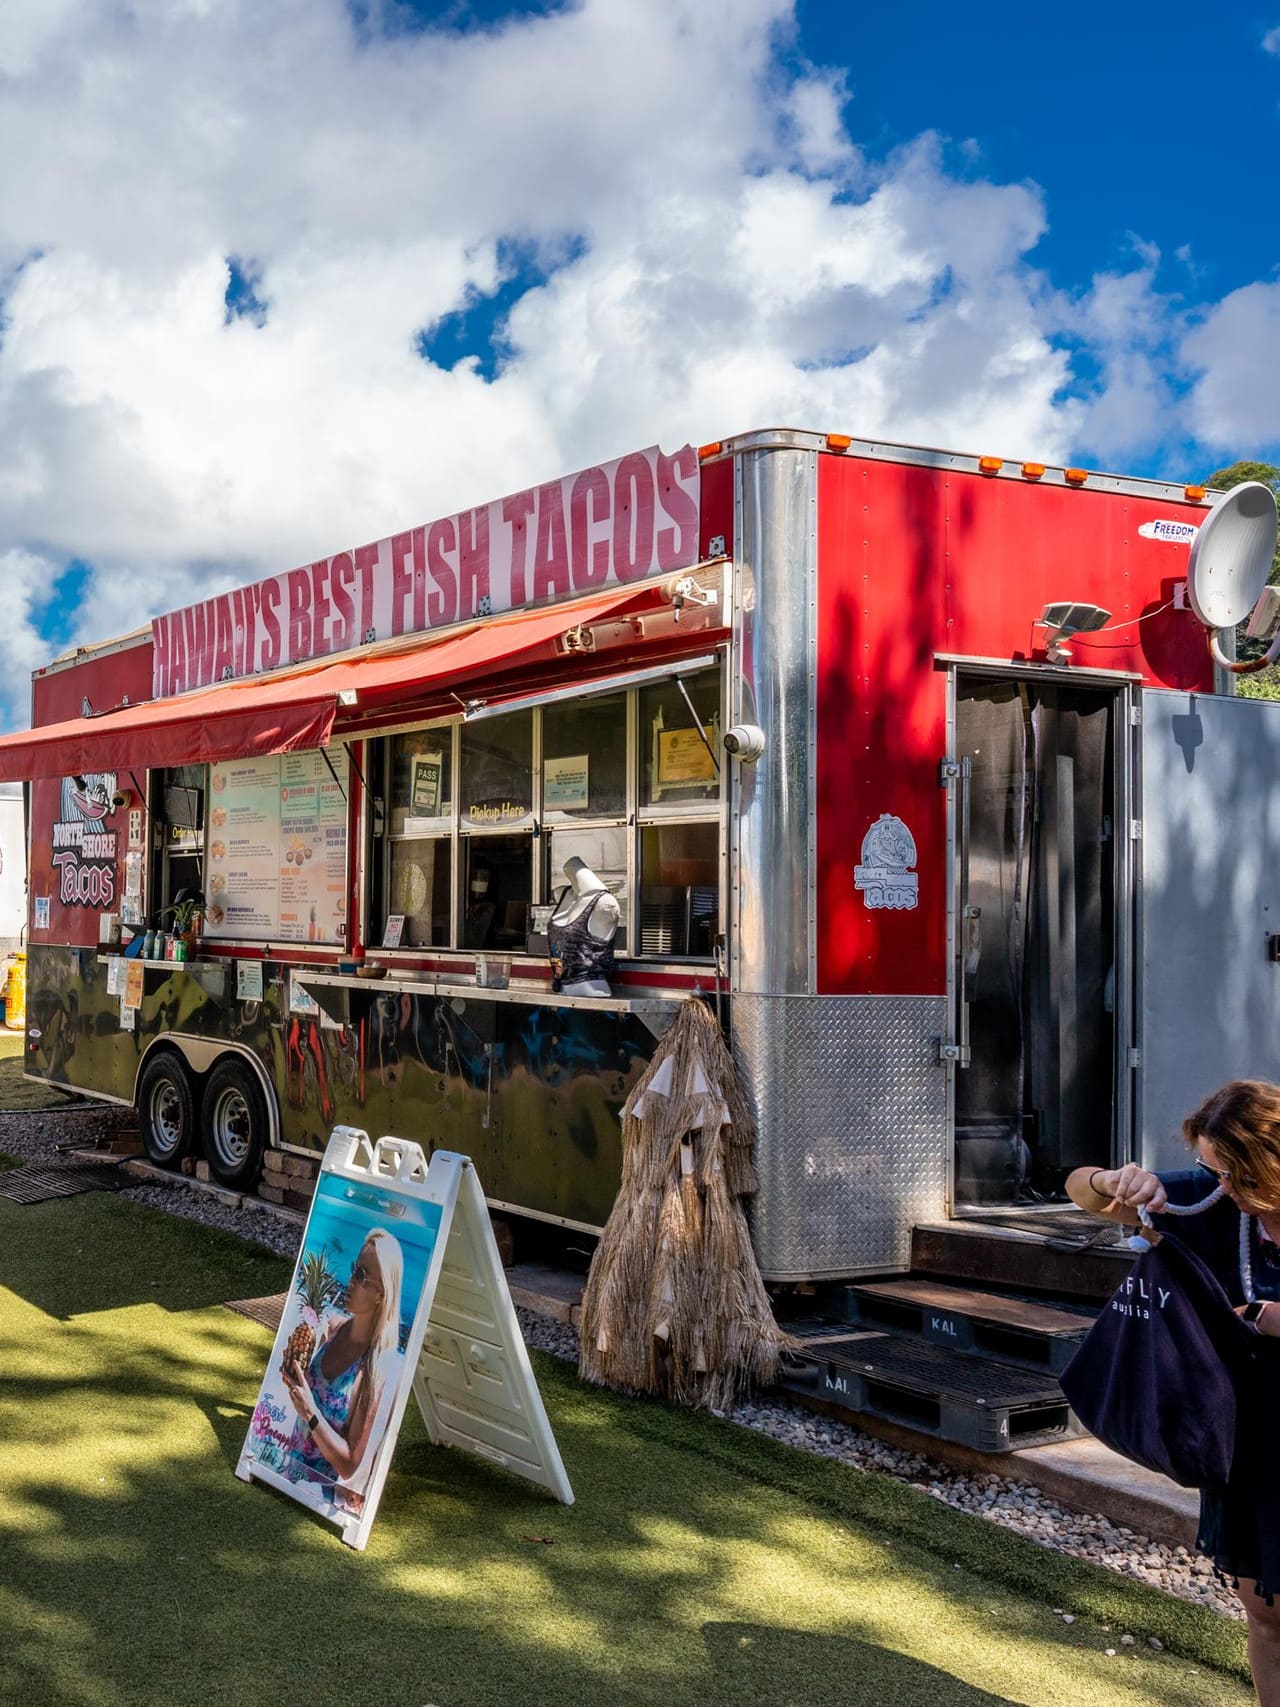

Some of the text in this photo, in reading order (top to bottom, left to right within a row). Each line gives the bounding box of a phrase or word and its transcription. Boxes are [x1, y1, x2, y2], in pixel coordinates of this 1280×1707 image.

[1154, 521, 1194, 537] FREEDOM
[152, 449, 699, 699] HAWAII'S BEST FISH TACOS
[418, 768, 437, 781] PASS
[470, 802, 524, 824] Pickup Here
[53, 823, 116, 859] NORTH SHORE
[931, 1317, 958, 1337] KAL
[999, 1418, 1008, 1438] 4
